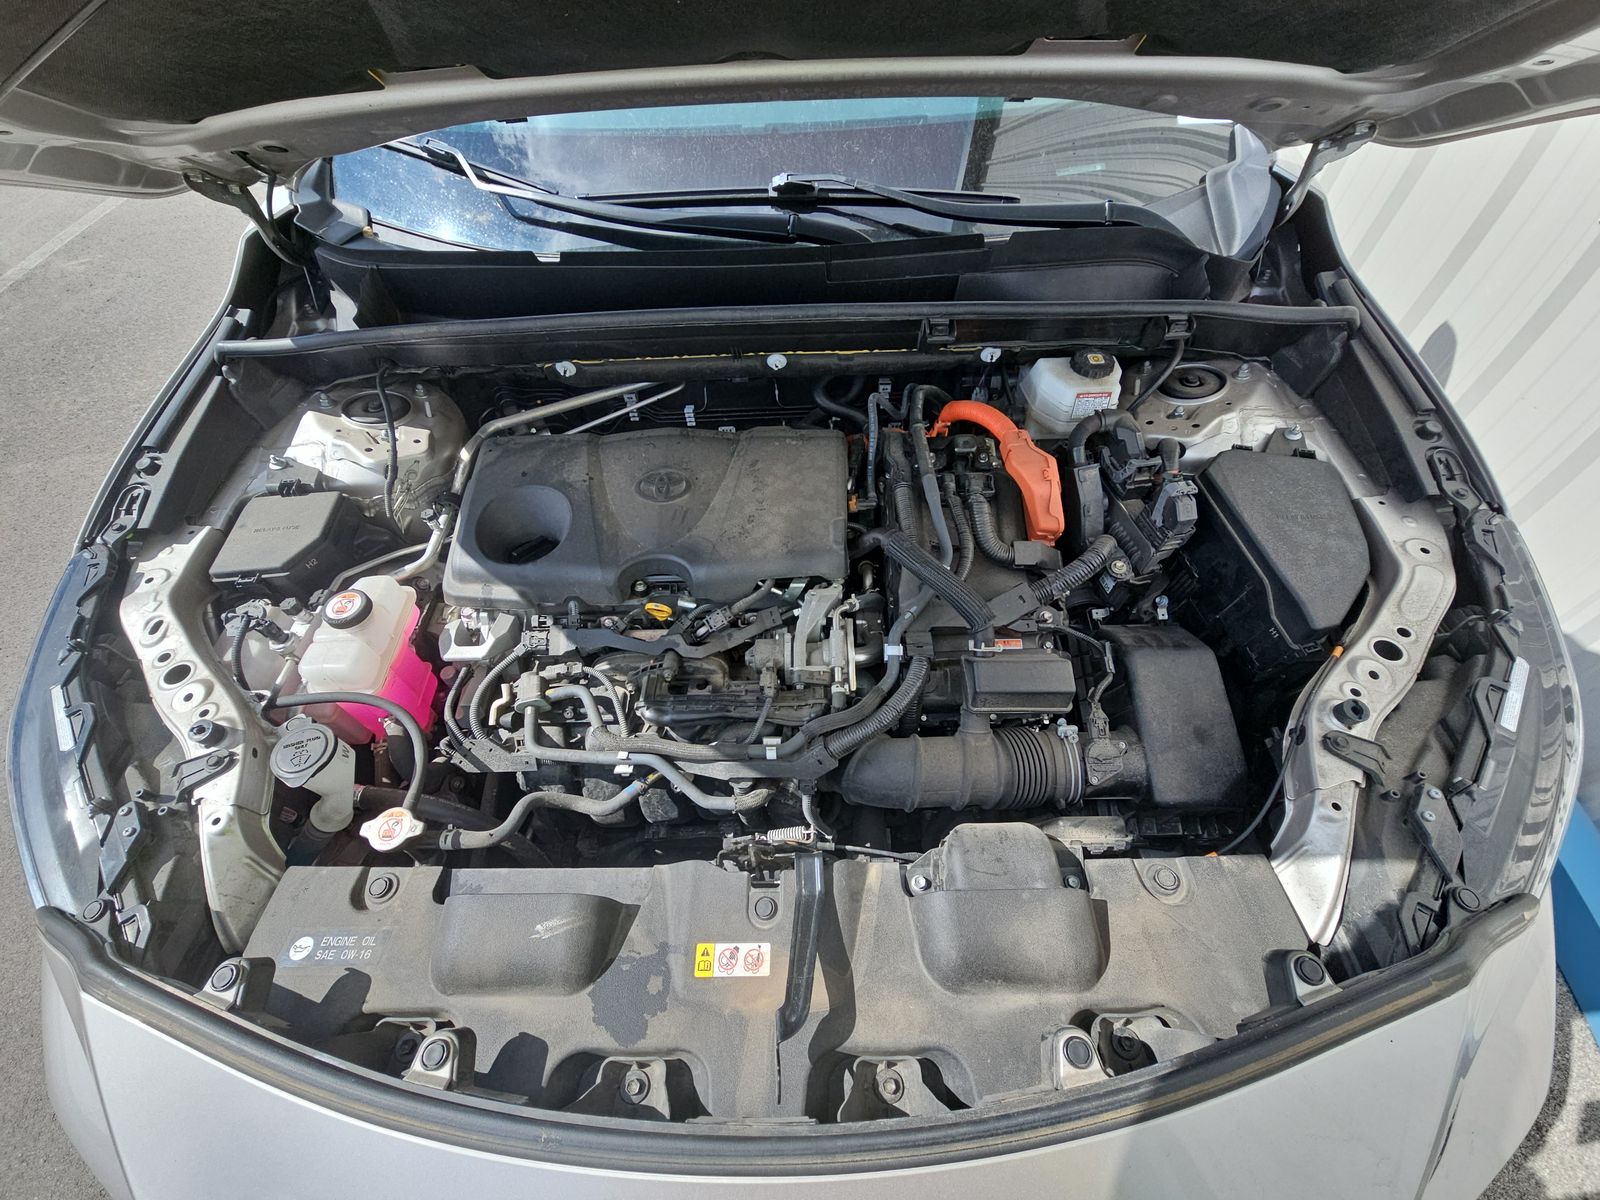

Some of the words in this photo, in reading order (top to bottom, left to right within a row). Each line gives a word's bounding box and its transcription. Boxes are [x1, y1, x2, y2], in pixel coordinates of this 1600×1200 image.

[305, 558, 319, 569] H2
[1268, 627, 1280, 639] H1
[320, 936, 358, 947] ENGINE
[361, 936, 377, 947] OIL
[314, 949, 337, 960] SAE
[340, 949, 373, 960] 0W-16
